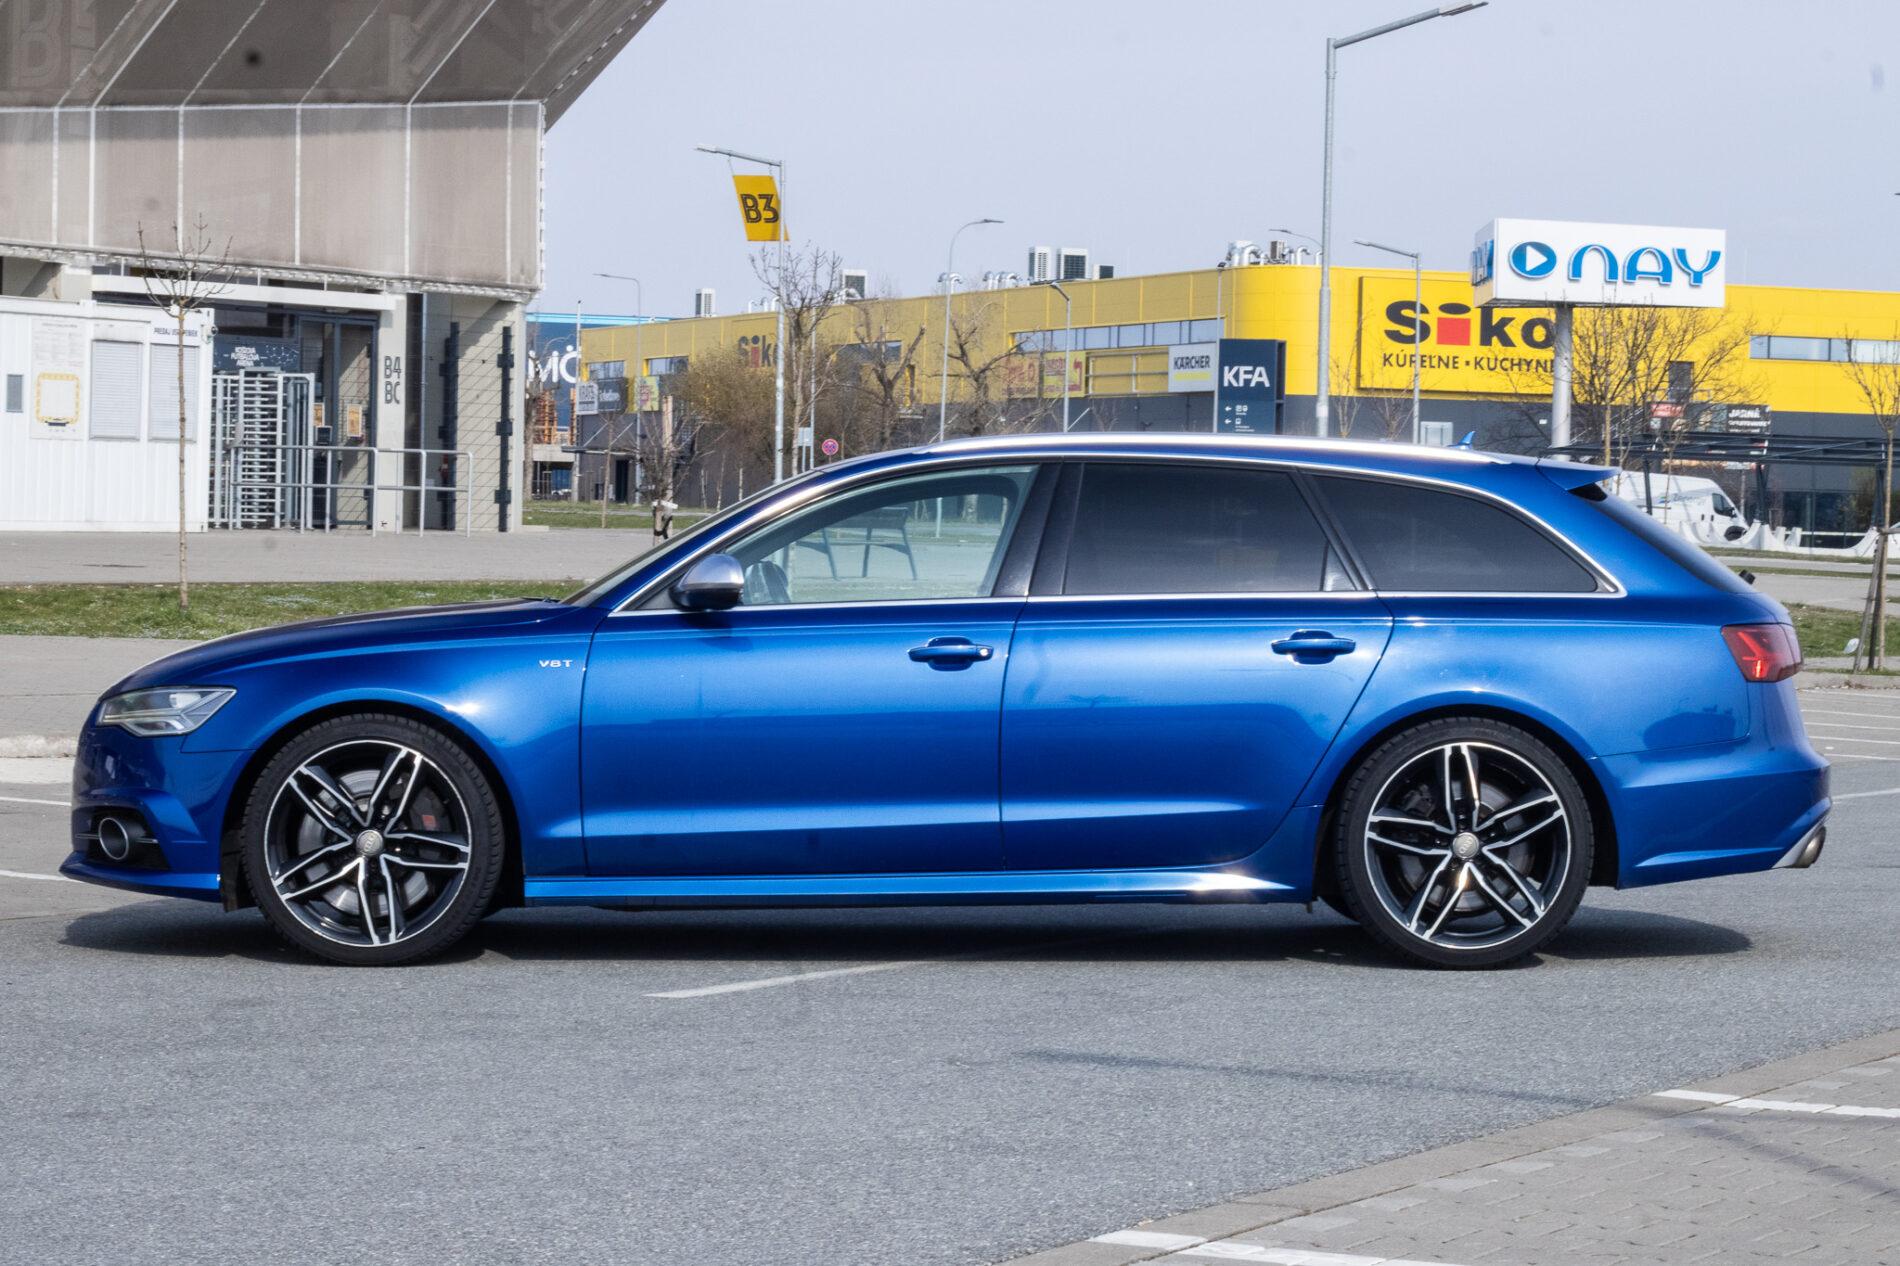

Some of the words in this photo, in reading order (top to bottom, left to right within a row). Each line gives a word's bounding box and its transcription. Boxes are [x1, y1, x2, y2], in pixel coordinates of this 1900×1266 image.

[740, 194, 779, 223] B3
[1384, 300, 1556, 350] Siko
[384, 356, 402, 378] B4
[1173, 355, 1211, 370] KÄRCHER
[1383, 349, 1460, 370] KÚPEĽNE
[1223, 366, 1271, 387] KFA
[384, 381, 400, 404] BC
[538, 659, 573, 668] V8T
